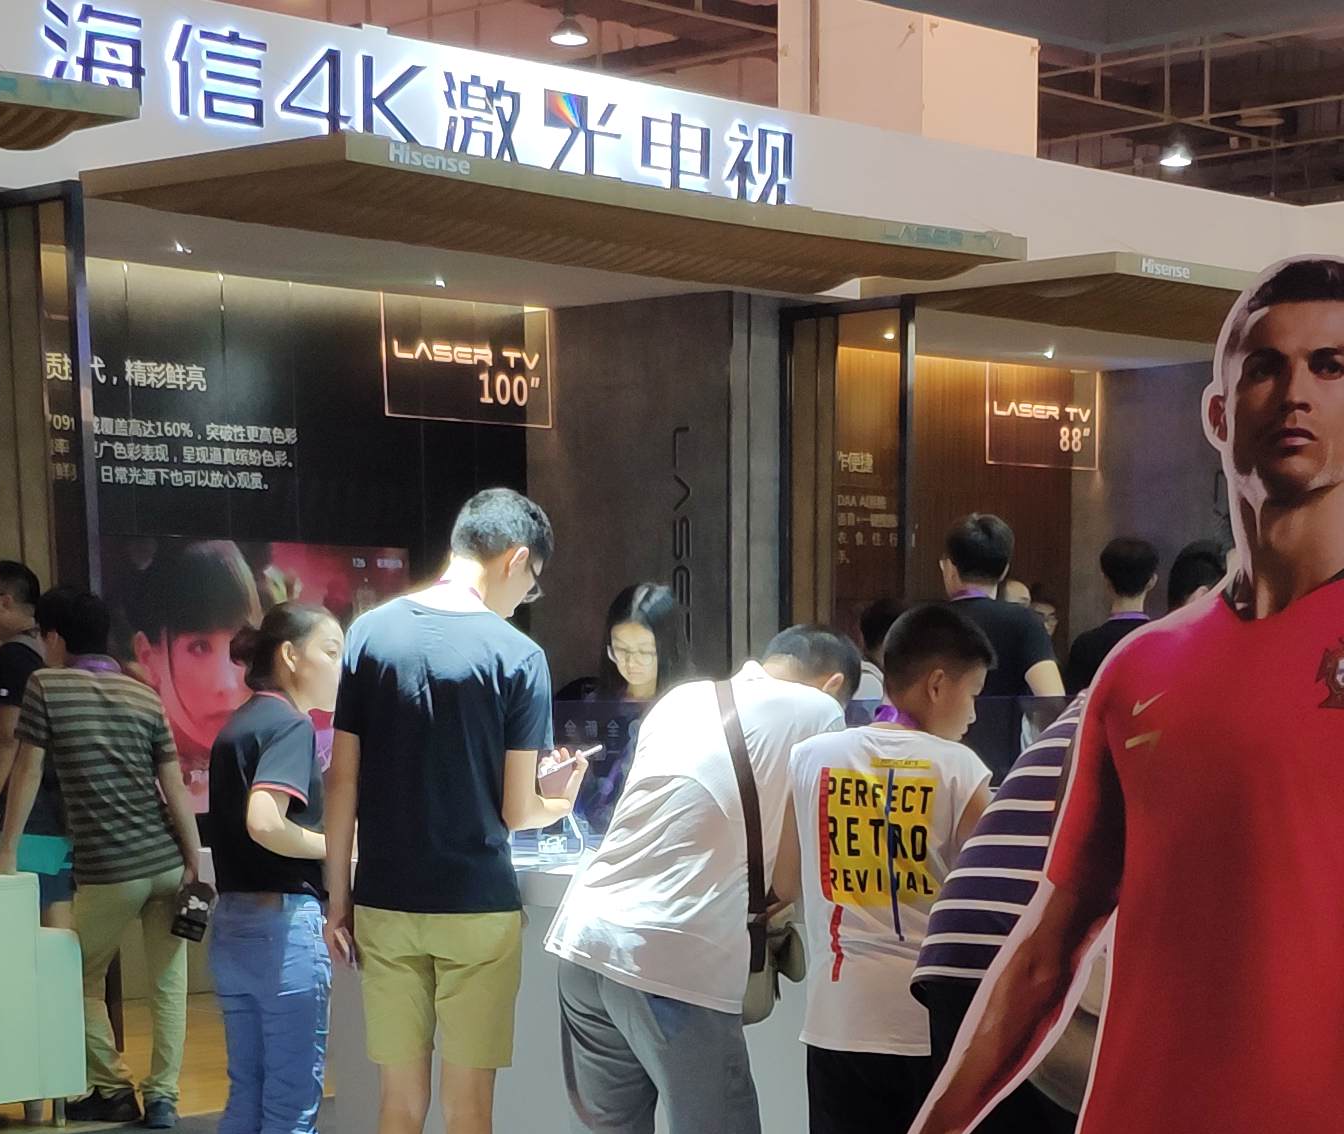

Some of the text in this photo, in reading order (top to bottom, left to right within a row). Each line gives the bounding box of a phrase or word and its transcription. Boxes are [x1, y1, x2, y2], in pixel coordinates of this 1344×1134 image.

[388, 140, 471, 175] Hisense
[1141, 257, 1191, 280] Hisense
[392, 338, 540, 371] LASER TV
[993, 400, 1091, 423] LASER TV
[828, 776, 934, 815] PERFECT
[828, 815, 928, 863] RETRO
